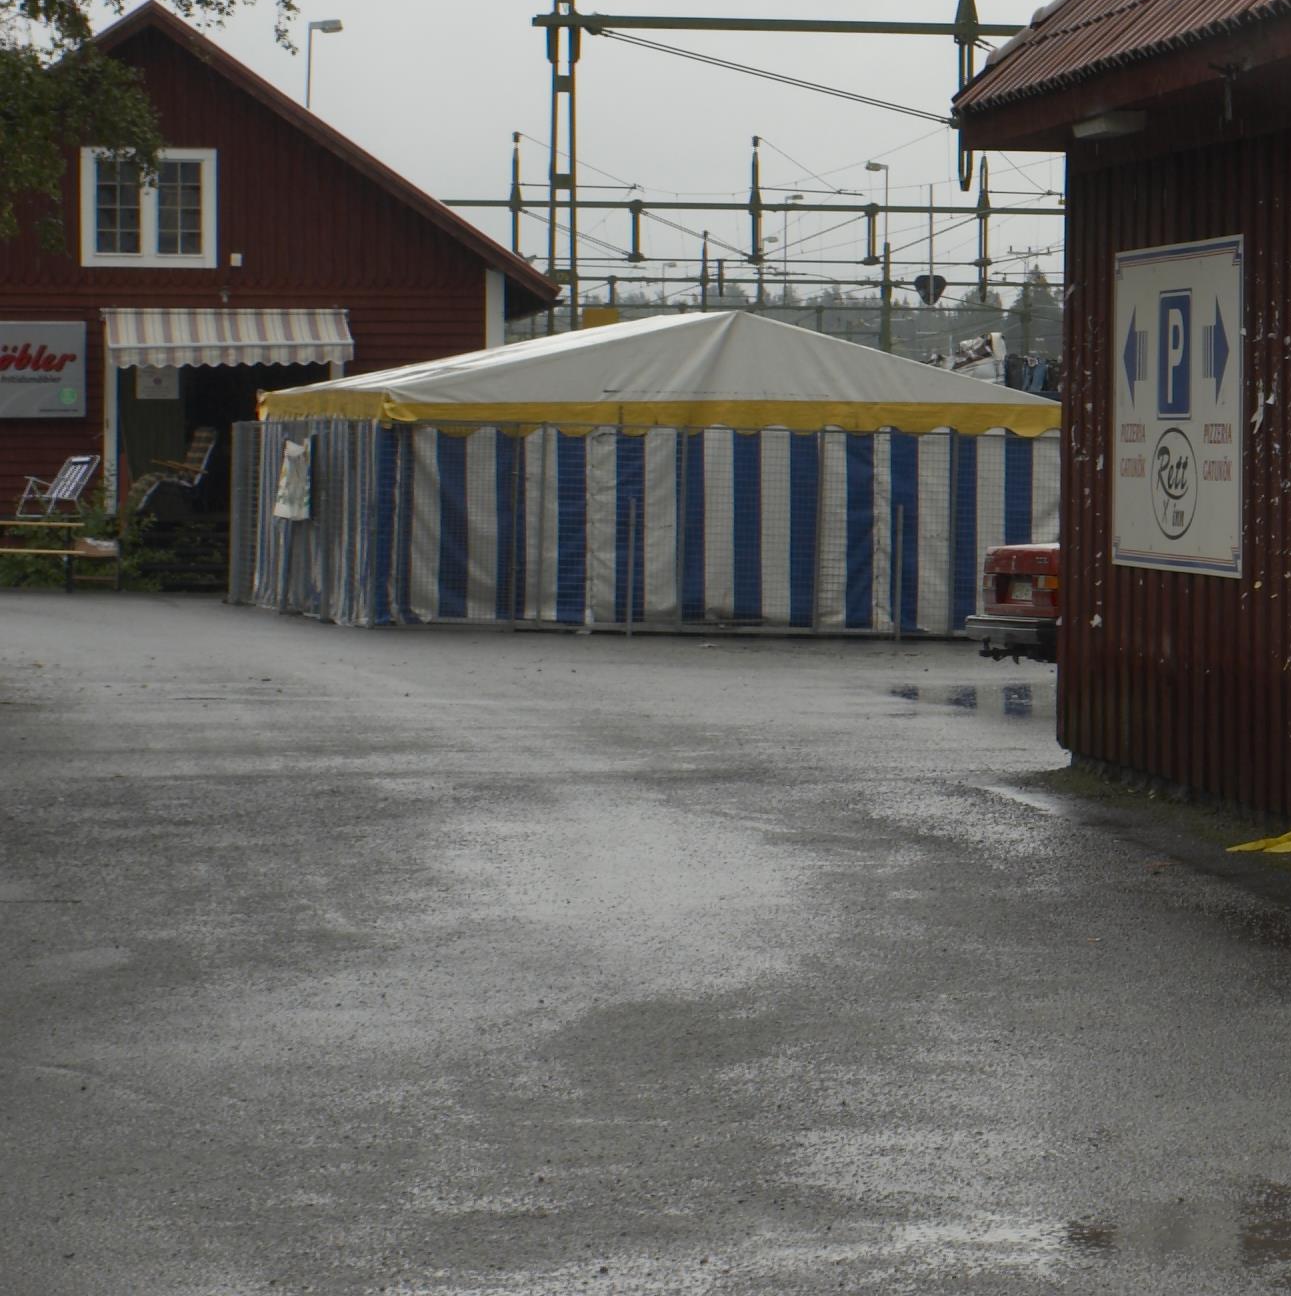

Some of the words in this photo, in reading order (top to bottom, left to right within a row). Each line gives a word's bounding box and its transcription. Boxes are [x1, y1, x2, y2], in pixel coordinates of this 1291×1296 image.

[1167, 308, 1185, 404] P
[1120, 423, 1145, 443] PIZZERIA
[1203, 423, 1232, 444] PIZZERIA
[1156, 446, 1189, 500] Rett
[1203, 456, 1232, 481] GATUKÖK
